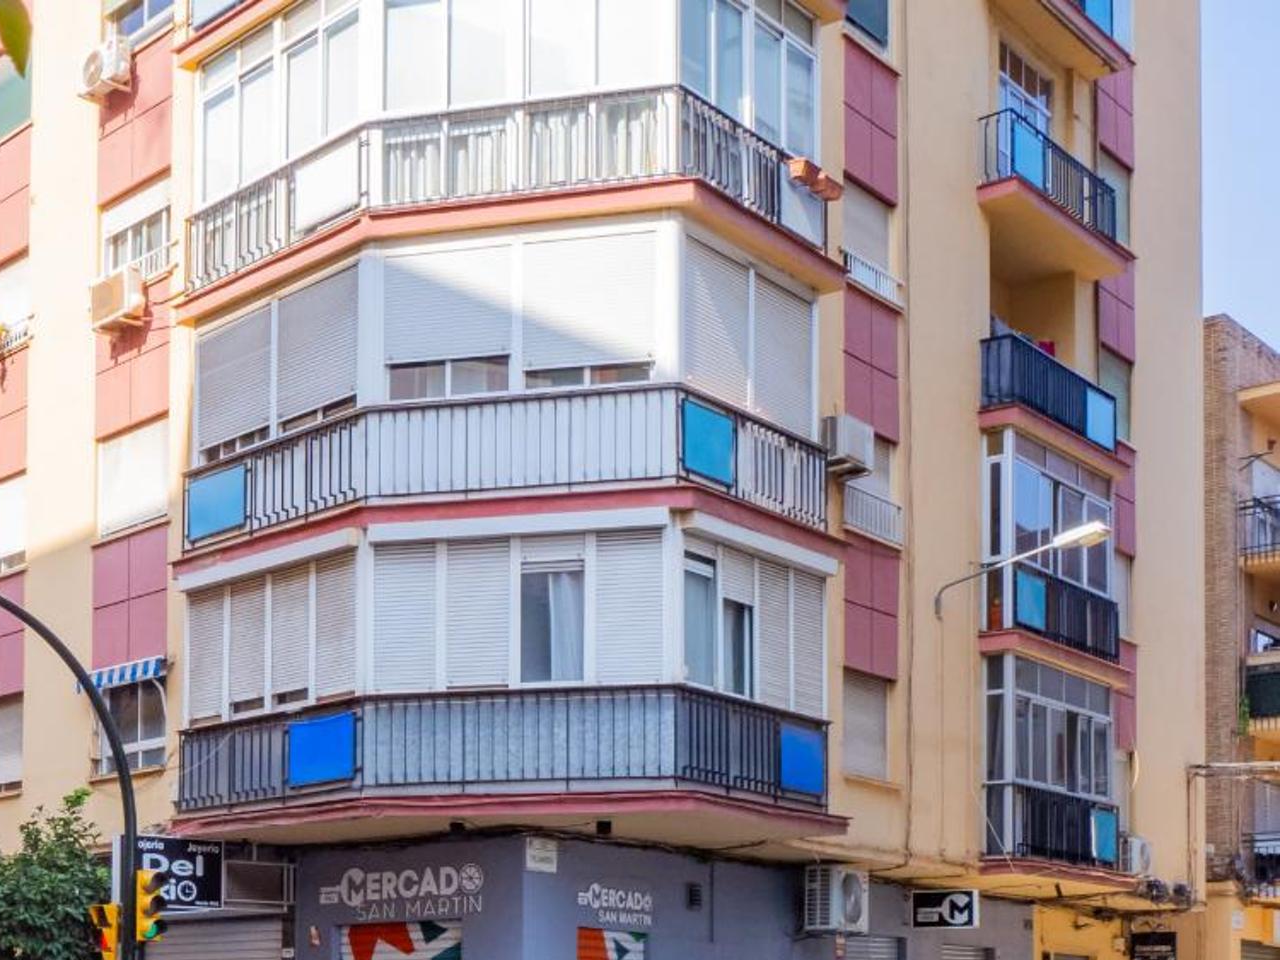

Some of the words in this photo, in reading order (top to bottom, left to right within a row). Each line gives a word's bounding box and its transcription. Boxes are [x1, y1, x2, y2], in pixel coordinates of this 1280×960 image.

[142, 852, 204, 877] Del
[356, 899, 396, 921] SAN
[598, 910, 618, 922] SAN
